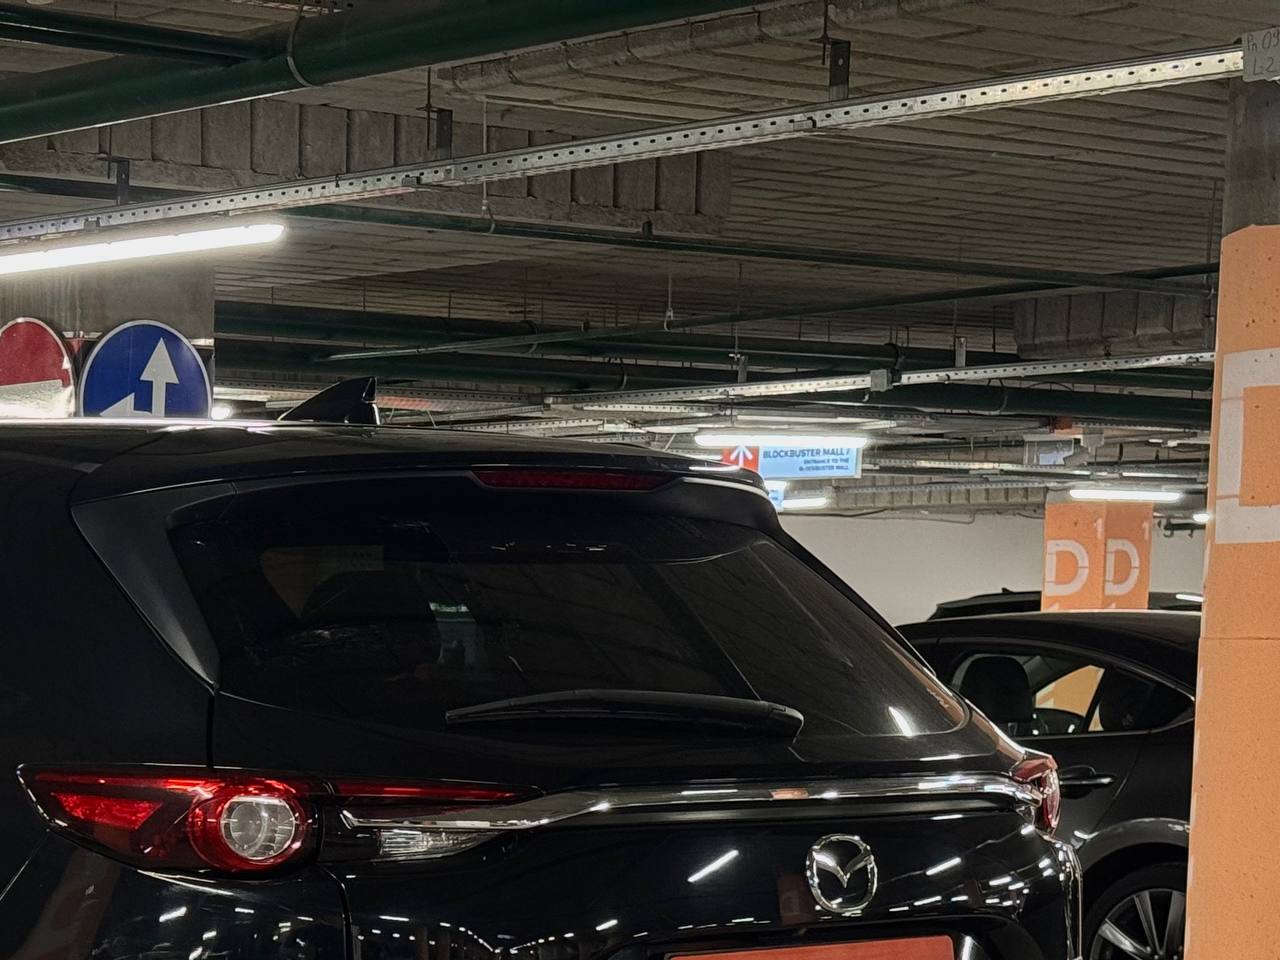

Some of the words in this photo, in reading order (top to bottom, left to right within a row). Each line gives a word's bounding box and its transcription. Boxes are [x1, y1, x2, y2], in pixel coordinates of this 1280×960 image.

[763, 448, 821, 459] BLOCKBUSTER
[823, 447, 844, 456] MALL
[1045, 539, 1089, 596] D
[1104, 538, 1140, 596] D
